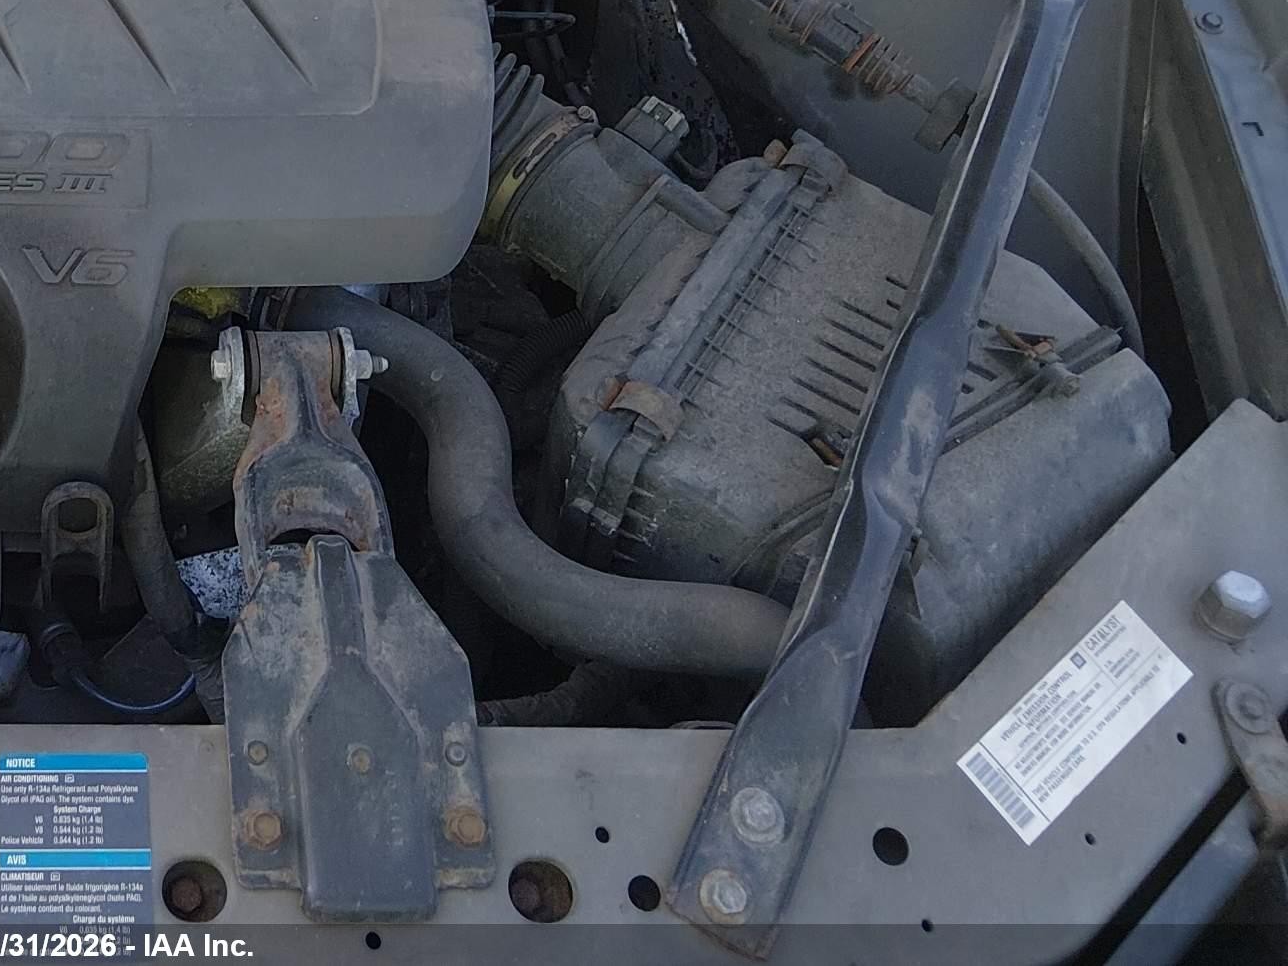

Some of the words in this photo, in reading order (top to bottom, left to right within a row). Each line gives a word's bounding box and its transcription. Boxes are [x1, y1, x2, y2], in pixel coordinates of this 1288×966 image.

[55, 173, 112, 194] III
[21, 244, 134, 286] V6
[1083, 614, 1121, 652] CATALYST
[6, 758, 36, 768] NOTICE
[1, 785, 12, 793] Use
[14, 785, 26, 793] only
[28, 785, 50, 793] R-134a
[52, 785, 86, 793] Refrigerant
[88, 785, 99, 793] and
[100, 785, 138, 793] Polyalkylene
[1, 796, 20, 804] Glycol
[20, 796, 28, 804] oil
[59, 796, 70, 804] The
[71, 796, 94, 804] system
[94, 796, 121, 804] contains
[54, 806, 77, 814] System
[78, 806, 102, 814] Charge
[72, 816, 80, 824] kg
[72, 826, 80, 834] kg
[1, 836, 20, 844] Police
[20, 836, 44, 844] Vehicle
[72, 836, 80, 844] kg
[6, 855, 26, 865] AVIS
[0, 873, 44, 881] CLIMATISEUR
[0, 884, 22, 892] Utiliser
[24, 884, 57, 892] seulement
[58, 884, 64, 892] le
[66, 884, 84, 892] fluide
[120, 884, 144, 892] R-134a
[0, 894, 8, 903] et
[8, 894, 17, 903] de
[38, 894, 47, 903] au
[0, 904, 8, 913] Le
[38, 904, 64, 913] contient
[64, 904, 74, 913] du
[72, 915, 96, 924] Charge
[97, 915, 106, 924] du
